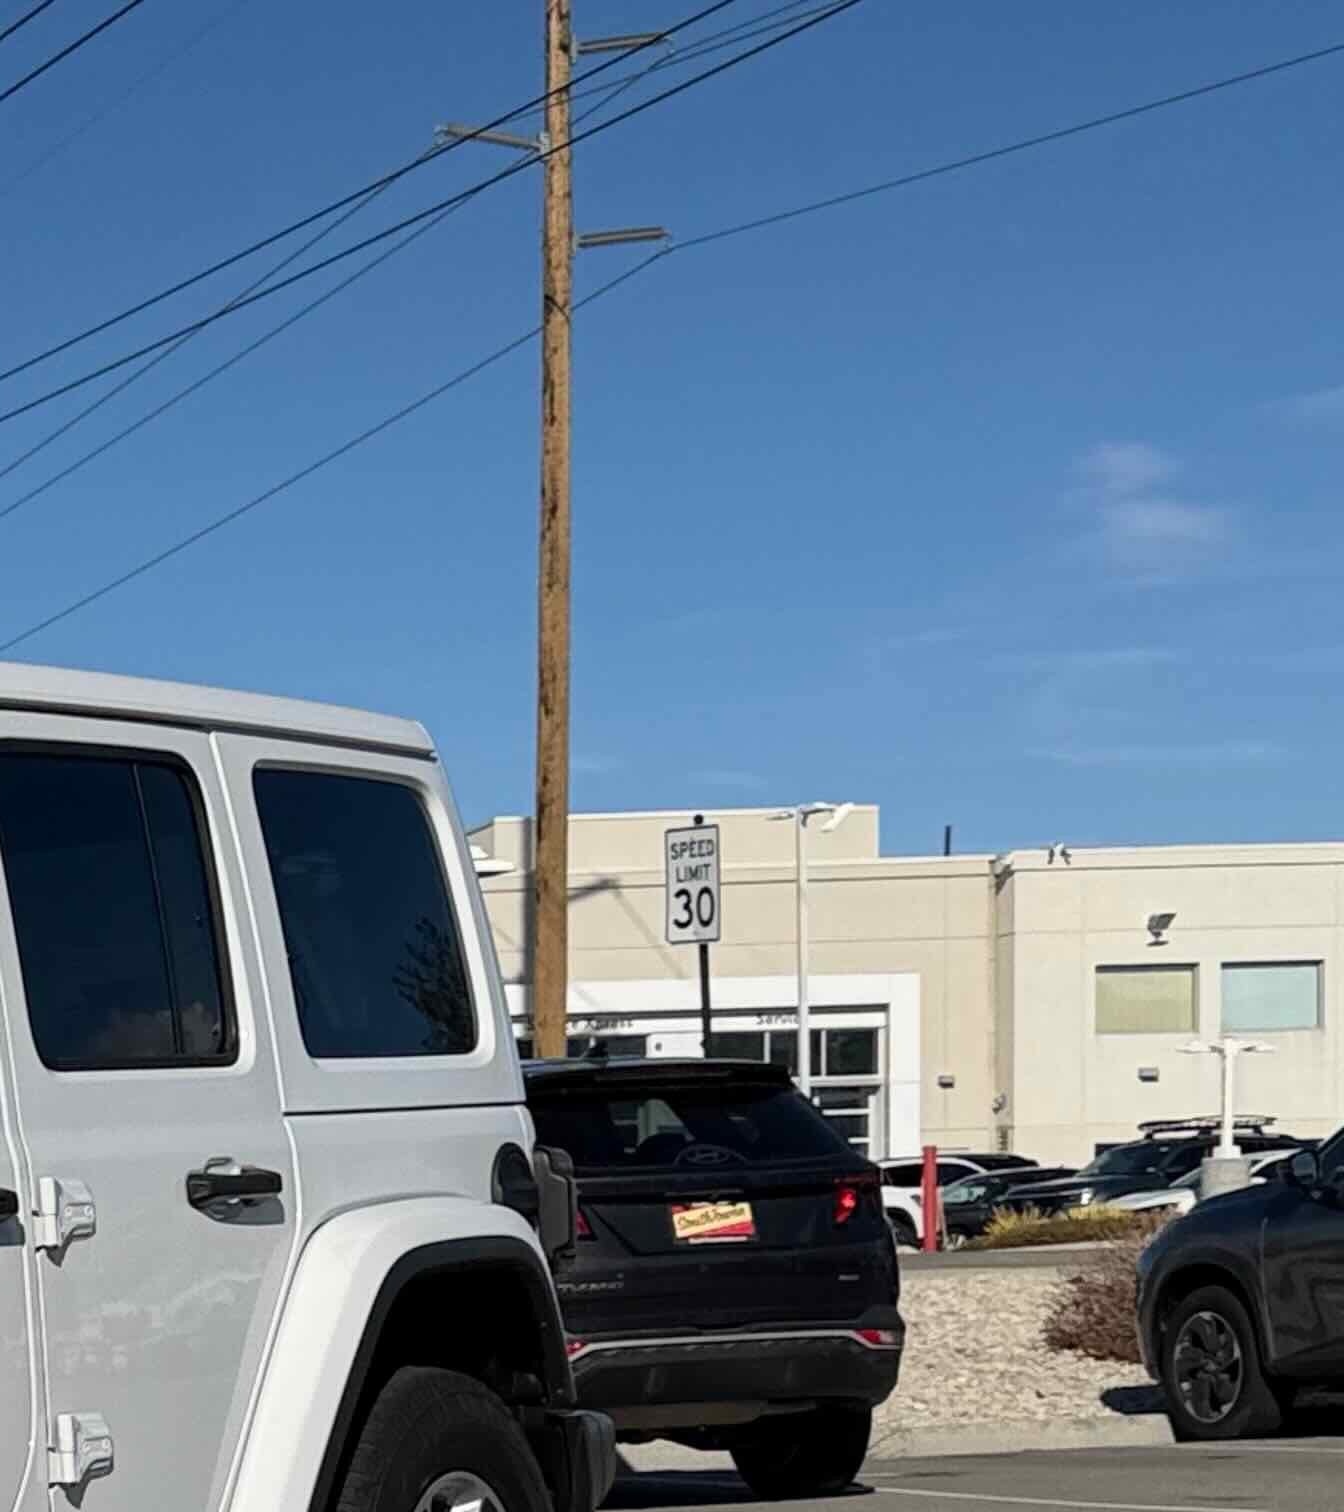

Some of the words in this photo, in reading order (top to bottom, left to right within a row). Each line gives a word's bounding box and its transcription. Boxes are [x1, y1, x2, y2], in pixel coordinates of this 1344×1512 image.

[670, 839, 714, 860] SPEED
[675, 863, 711, 883] LIMIT
[673, 886, 715, 929] 30
